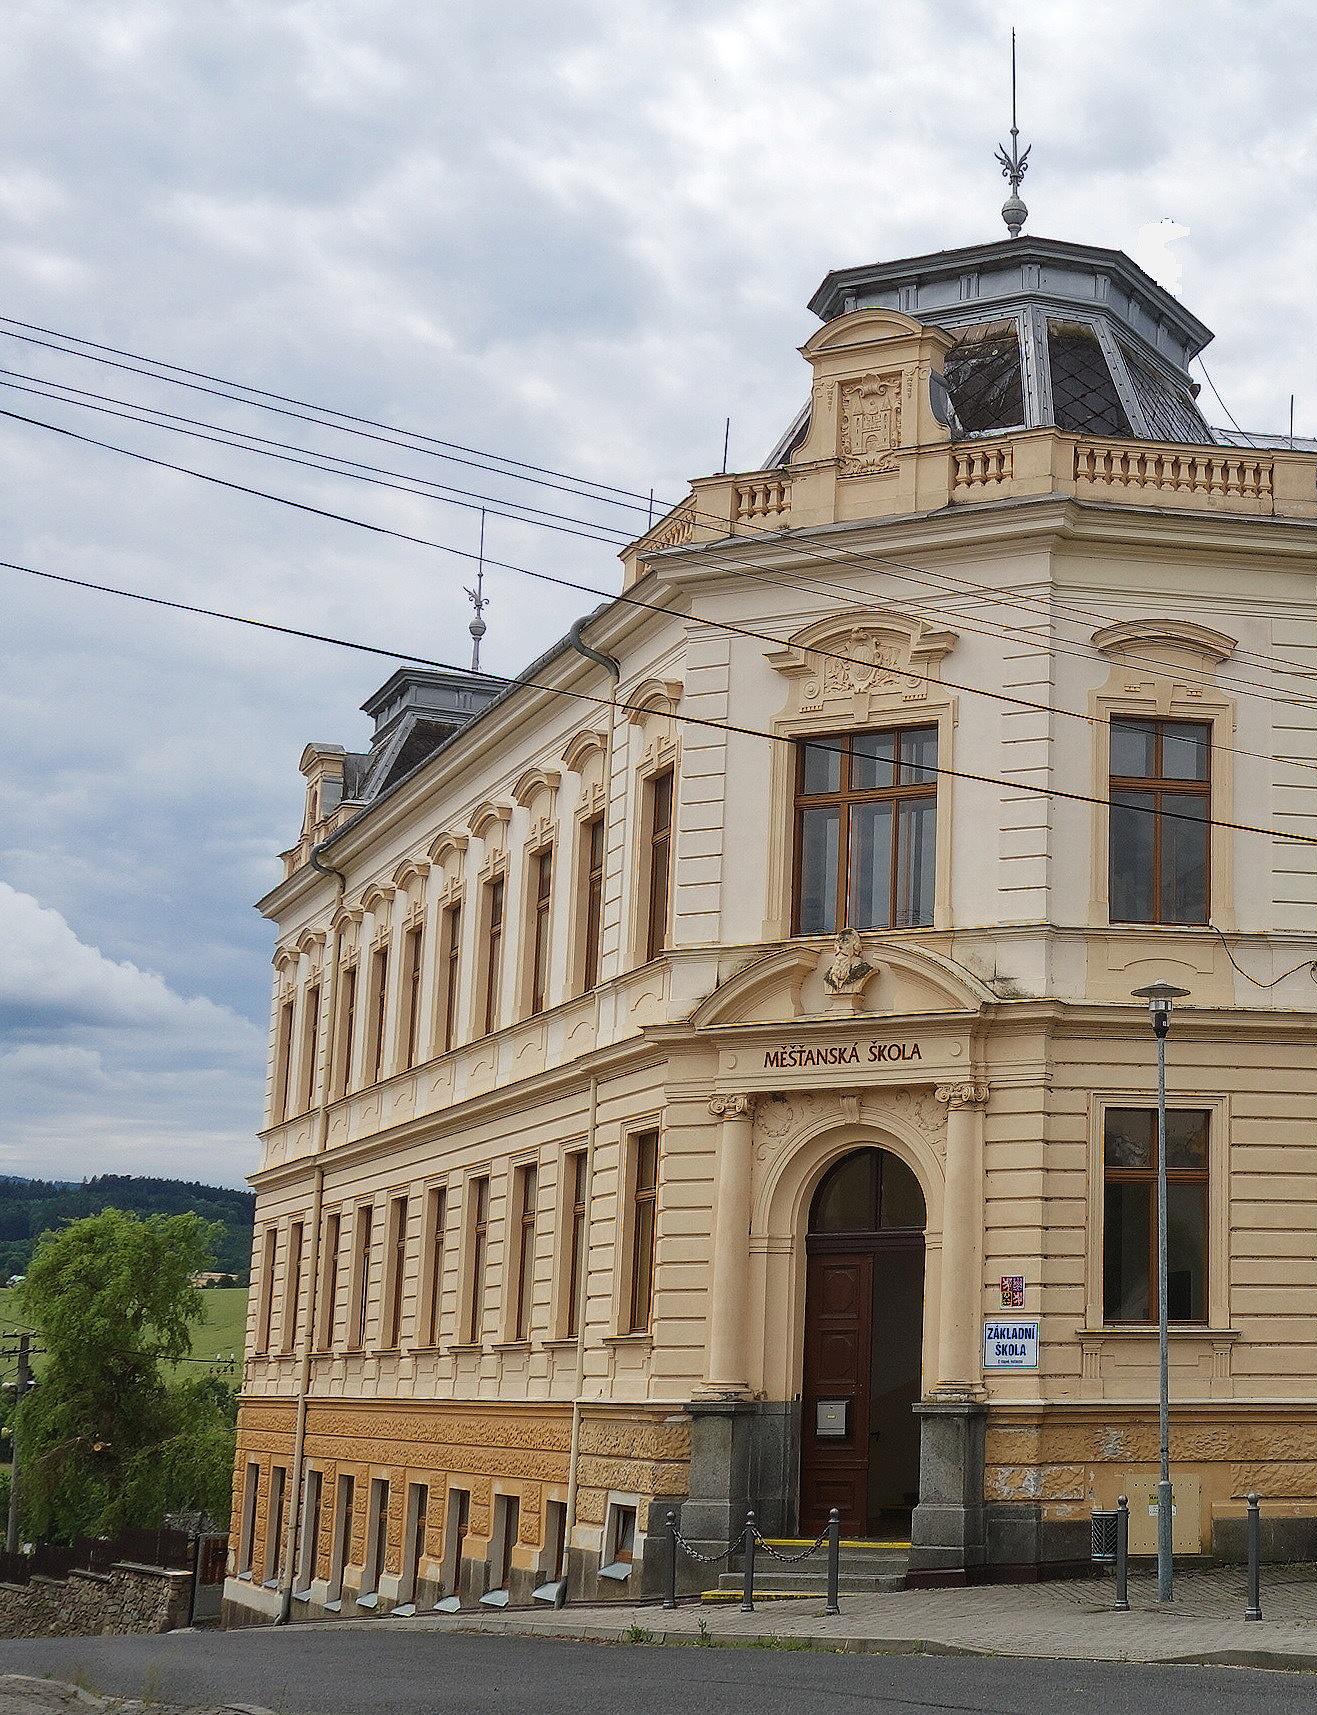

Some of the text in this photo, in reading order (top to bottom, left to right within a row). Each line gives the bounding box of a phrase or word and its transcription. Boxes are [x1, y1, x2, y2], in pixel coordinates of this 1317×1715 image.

[764, 1040, 923, 1068] MĚŠŤANSKÁ ŠKOLA
[987, 1325, 1035, 1339] ZÁKLADNÍ
[995, 1342, 1026, 1356] ŠKOLA
